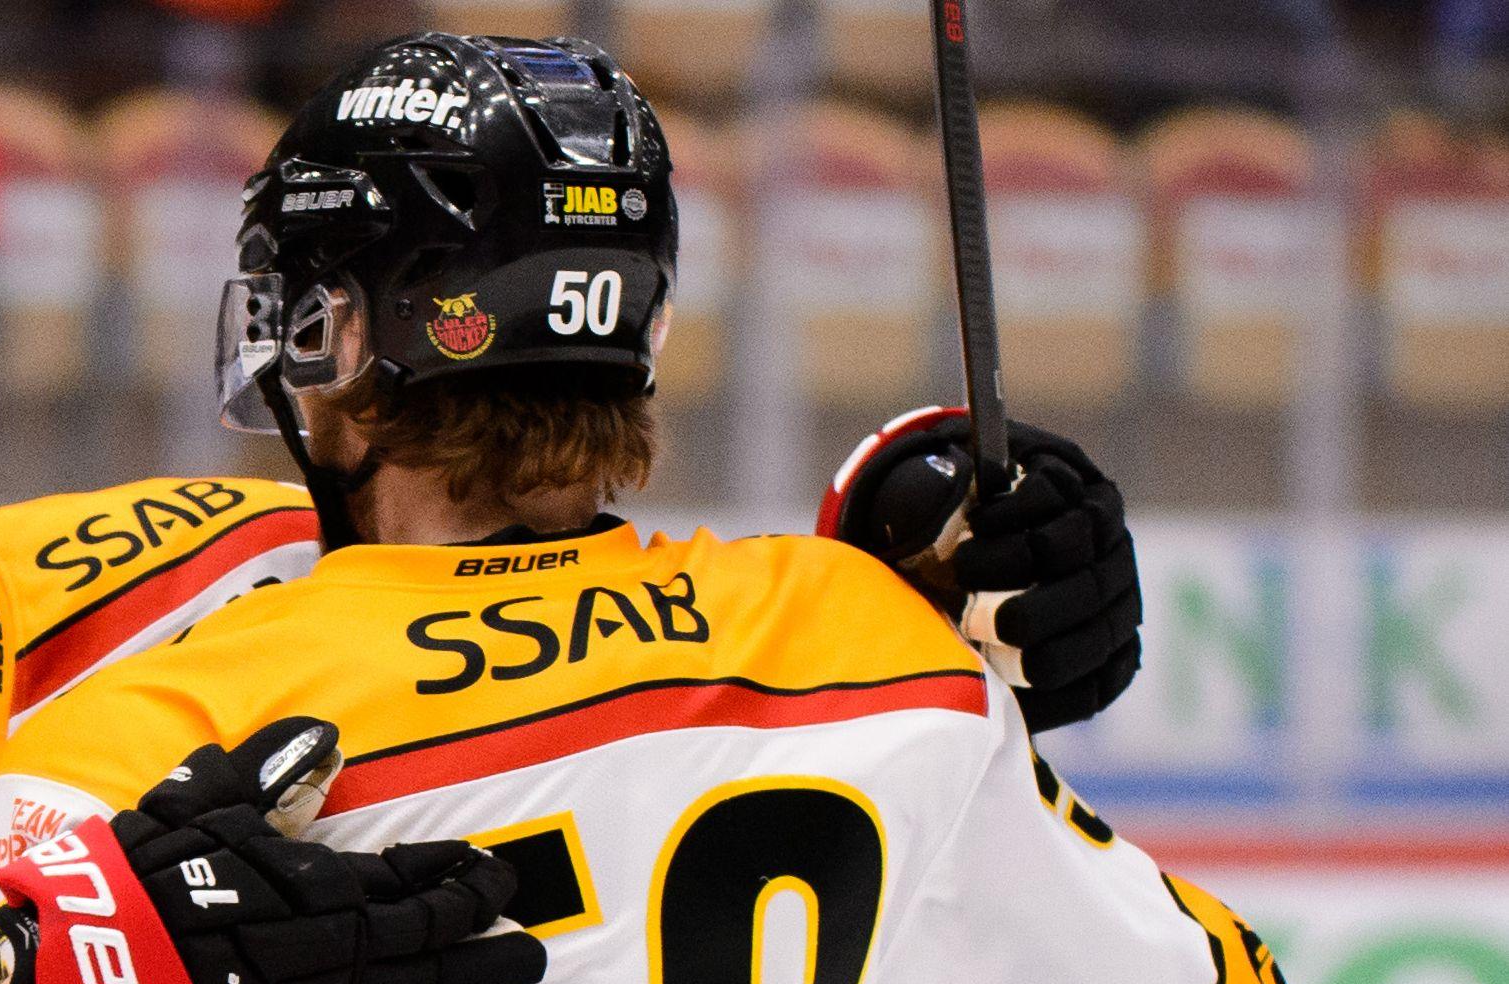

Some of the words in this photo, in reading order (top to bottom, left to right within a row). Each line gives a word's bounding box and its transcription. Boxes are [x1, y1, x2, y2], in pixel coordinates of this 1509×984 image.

[336, 78, 470, 130] vinter.
[281, 188, 355, 213] BAUER
[563, 186, 618, 214] JIAB
[548, 270, 623, 336] 50
[36, 481, 246, 592] SSAB
[454, 549, 580, 578] BAUER
[407, 572, 710, 695] SSAB
[12, 798, 67, 840] TEAM
